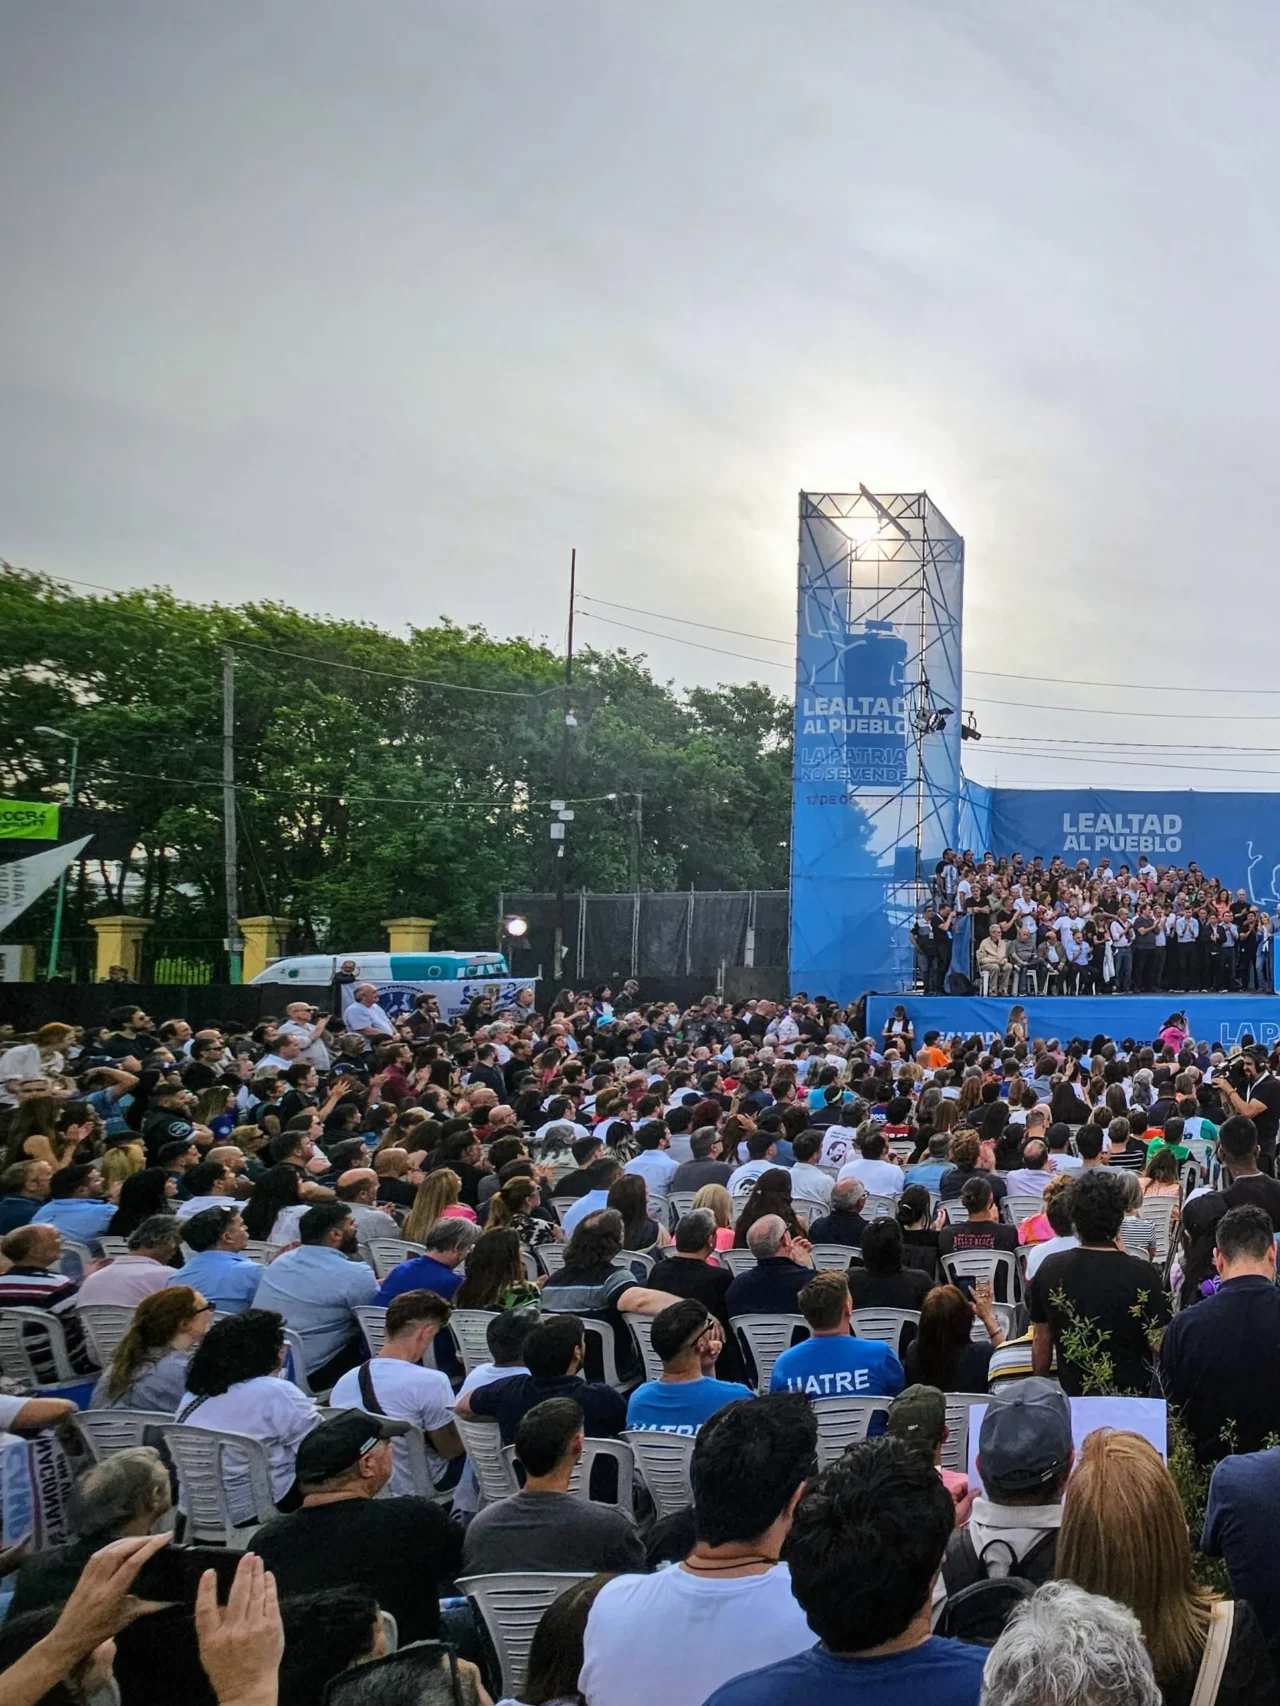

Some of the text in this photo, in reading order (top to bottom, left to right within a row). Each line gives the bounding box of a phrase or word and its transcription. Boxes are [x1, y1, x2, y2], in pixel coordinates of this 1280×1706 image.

[803, 697, 907, 716] LEALTAD
[803, 719, 909, 734] AL PUEBLO
[801, 747, 908, 765] LA PATRIA
[801, 767, 910, 782] NO SE VENDE
[820, 795, 835, 805] DE
[1063, 812, 1183, 835] LEALTAD
[1062, 835, 1182, 852] AL PUEBLO
[1220, 1022, 1257, 1046] LA
[787, 1368, 870, 1395] UATRE
